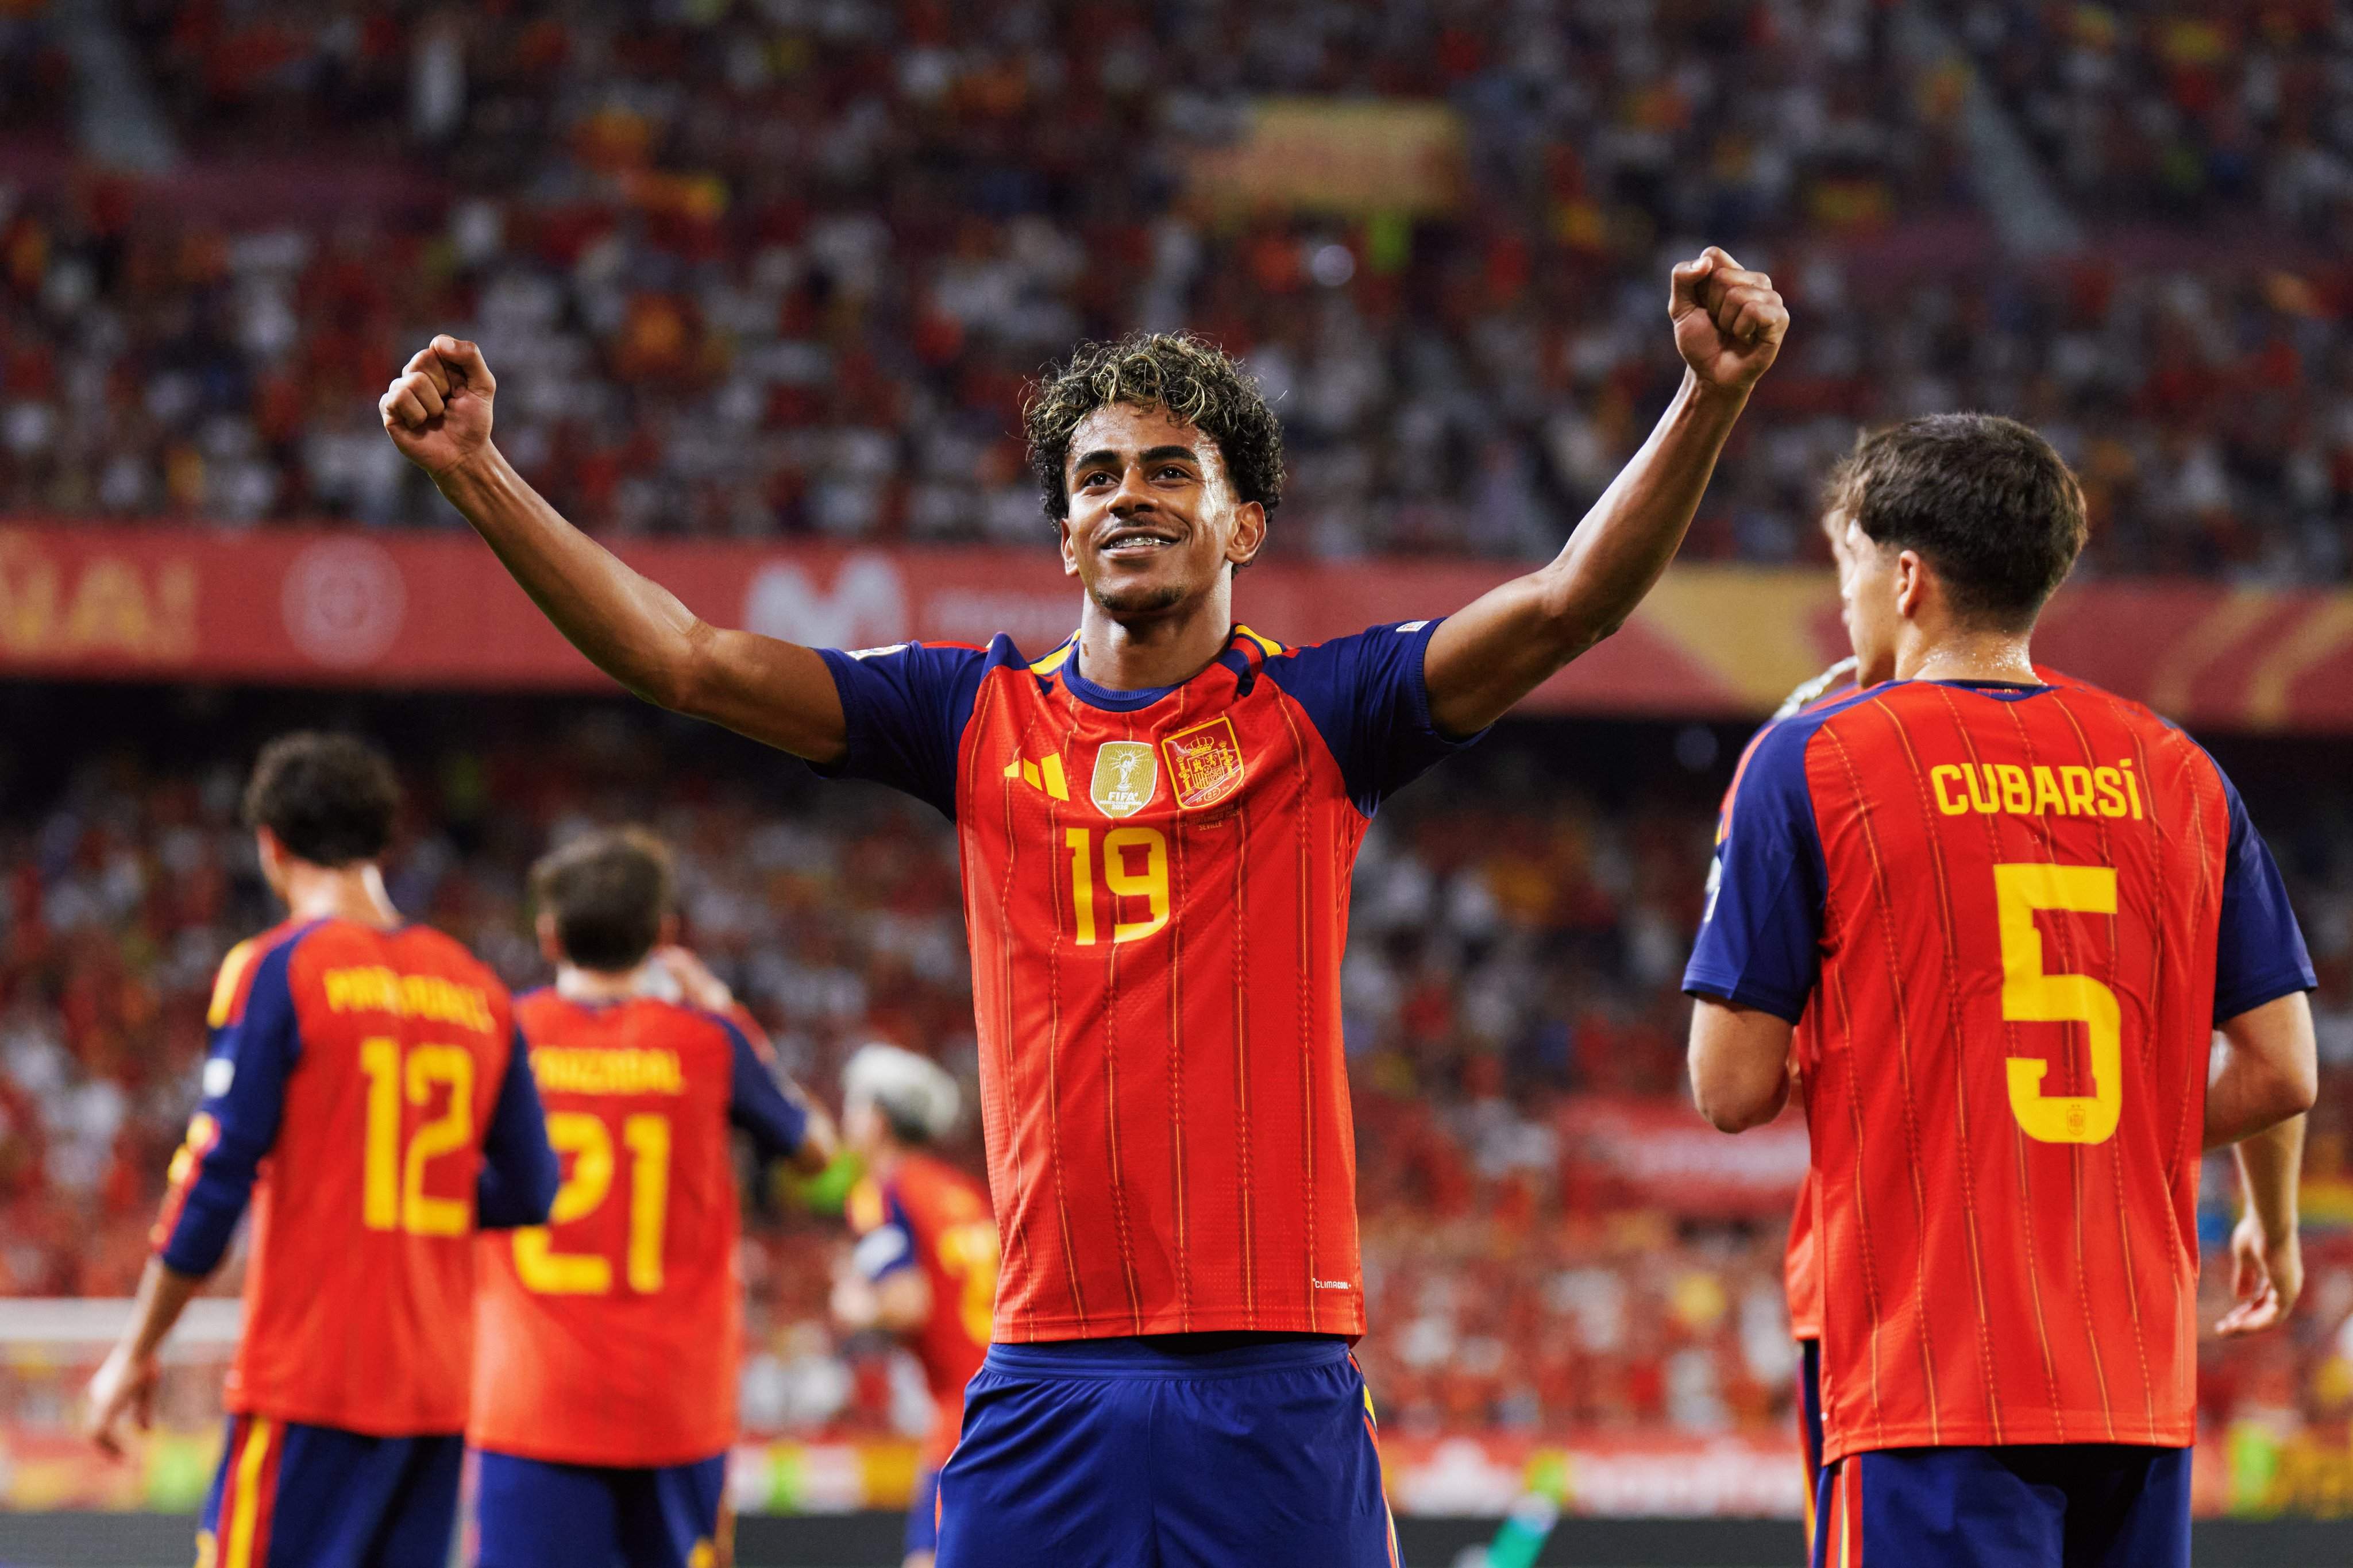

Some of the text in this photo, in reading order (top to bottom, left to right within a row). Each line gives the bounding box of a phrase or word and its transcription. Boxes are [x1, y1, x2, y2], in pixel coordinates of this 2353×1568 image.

[1108, 791, 1136, 801] FIFA
[1199, 820, 1223, 831] SEVILLE
[1931, 759, 2143, 820] CUBARSÍ
[1066, 827, 1170, 945] 19
[1993, 863, 2122, 1145] 5
[360, 1038, 473, 1236] 12
[512, 1112, 670, 1295] 21
